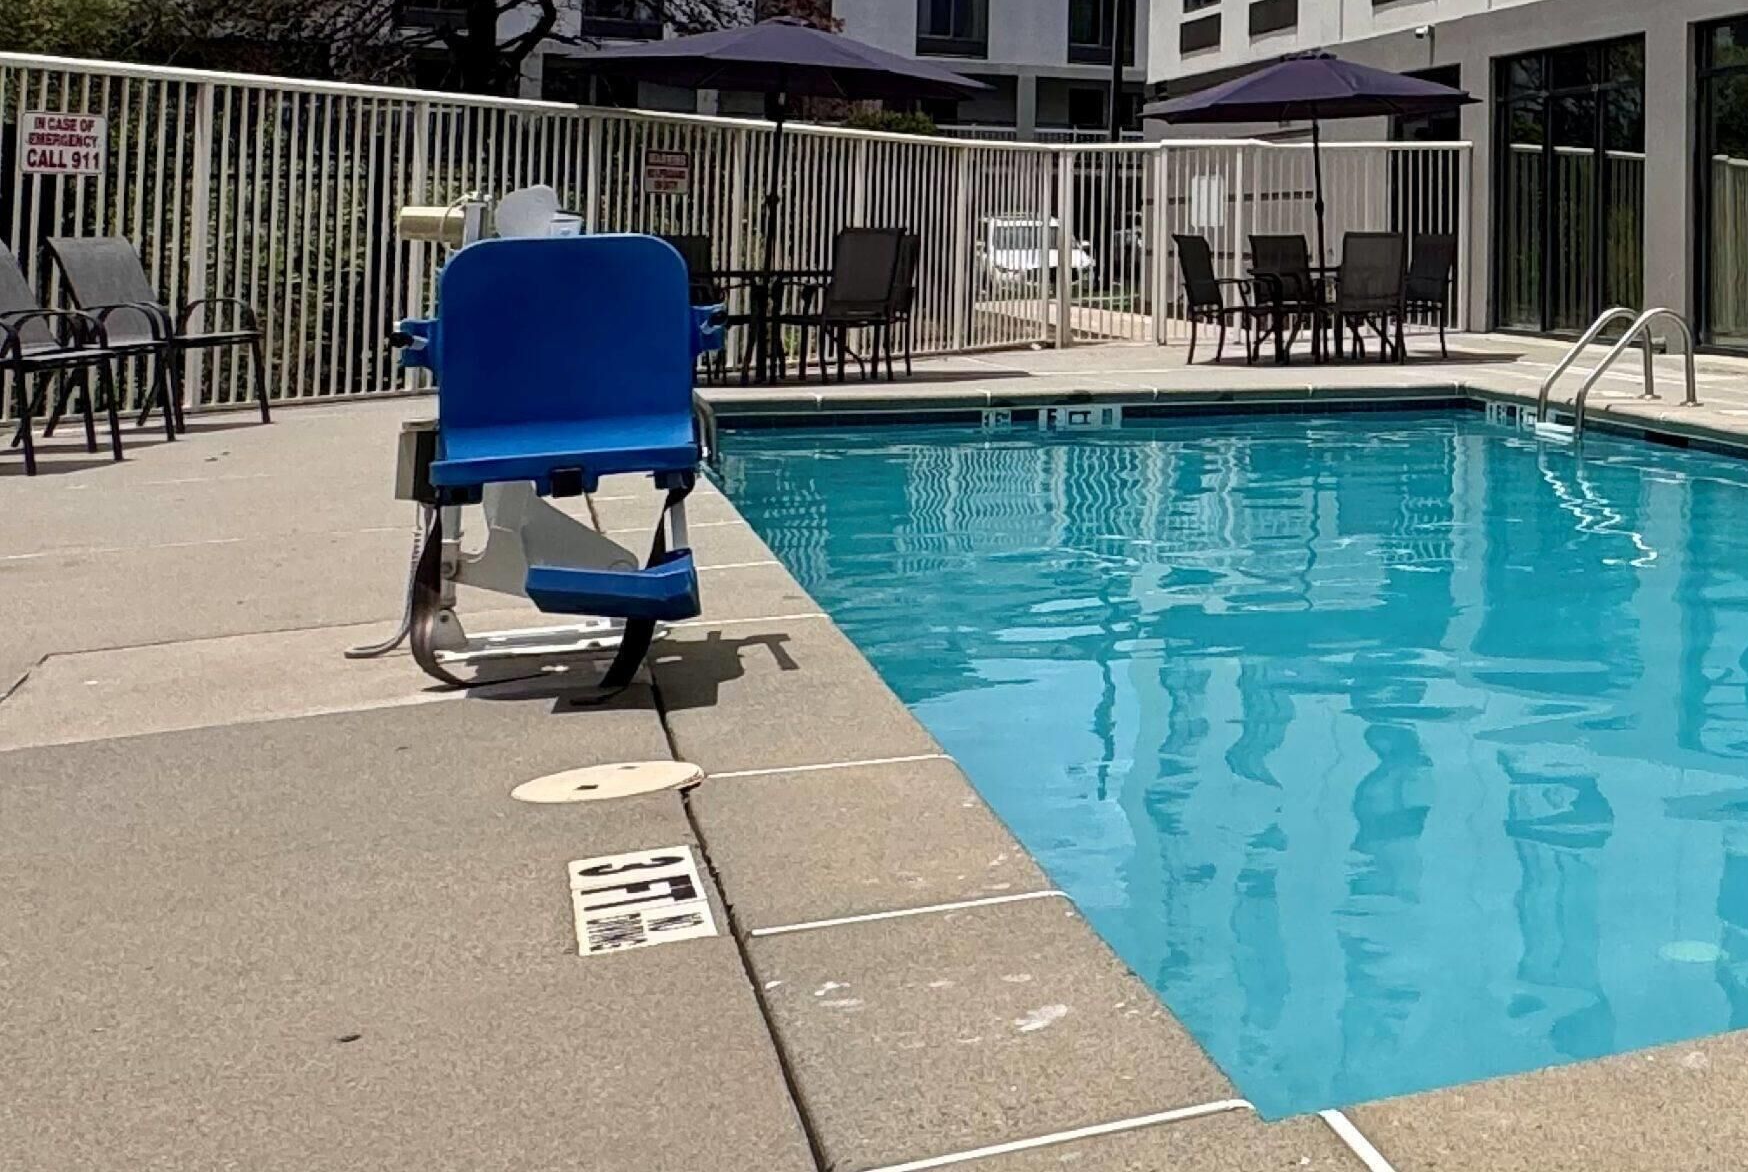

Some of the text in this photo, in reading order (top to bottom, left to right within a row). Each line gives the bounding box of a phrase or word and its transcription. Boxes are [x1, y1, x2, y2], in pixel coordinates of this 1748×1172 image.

[34, 117, 95, 132] IN CASE OF
[28, 132, 98, 148] EMERGENCY
[27, 148, 100, 169] CALL 911
[578, 856, 698, 911] 3 FT
